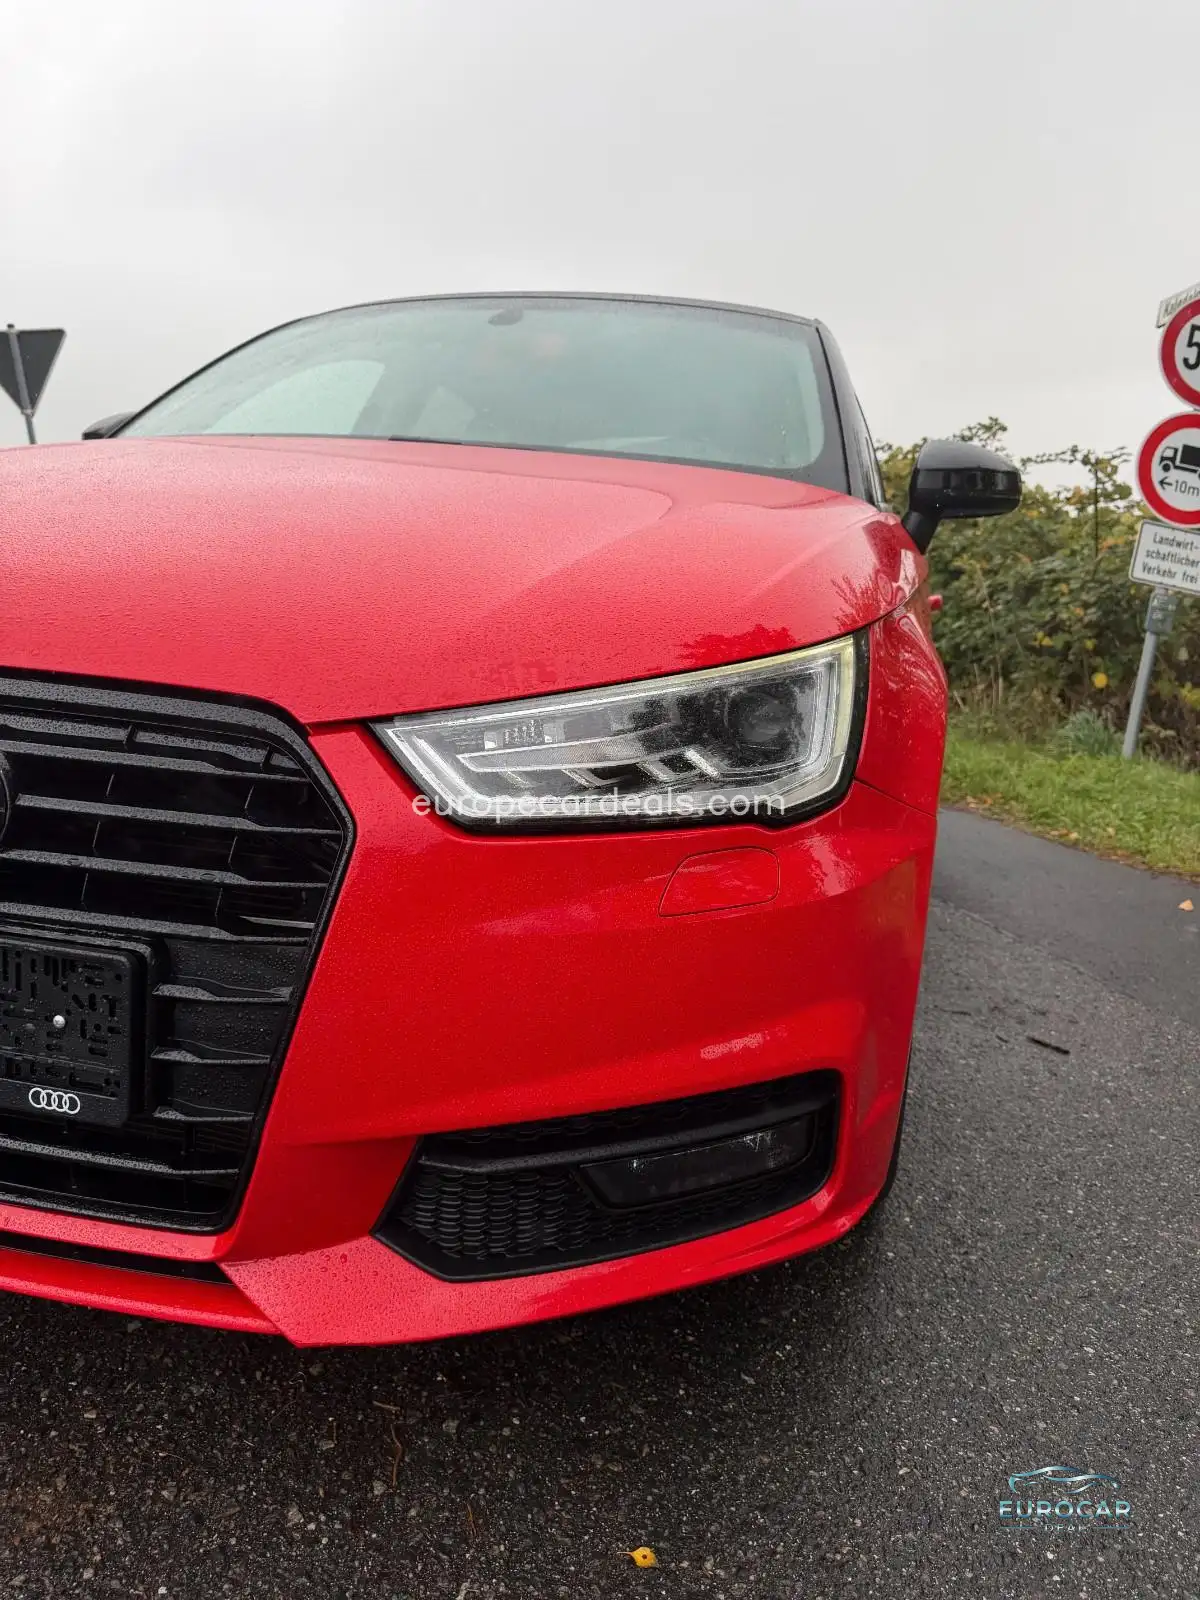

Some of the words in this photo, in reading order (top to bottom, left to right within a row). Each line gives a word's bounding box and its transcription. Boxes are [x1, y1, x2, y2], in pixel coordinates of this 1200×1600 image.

[1174, 479, 1200, 497] 10m
[1153, 532, 1199, 551] Landwirt-
[1146, 549, 1200, 569] schaftlicher
[1142, 561, 1177, 577] Verkehr
[1182, 571, 1198, 584] frei
